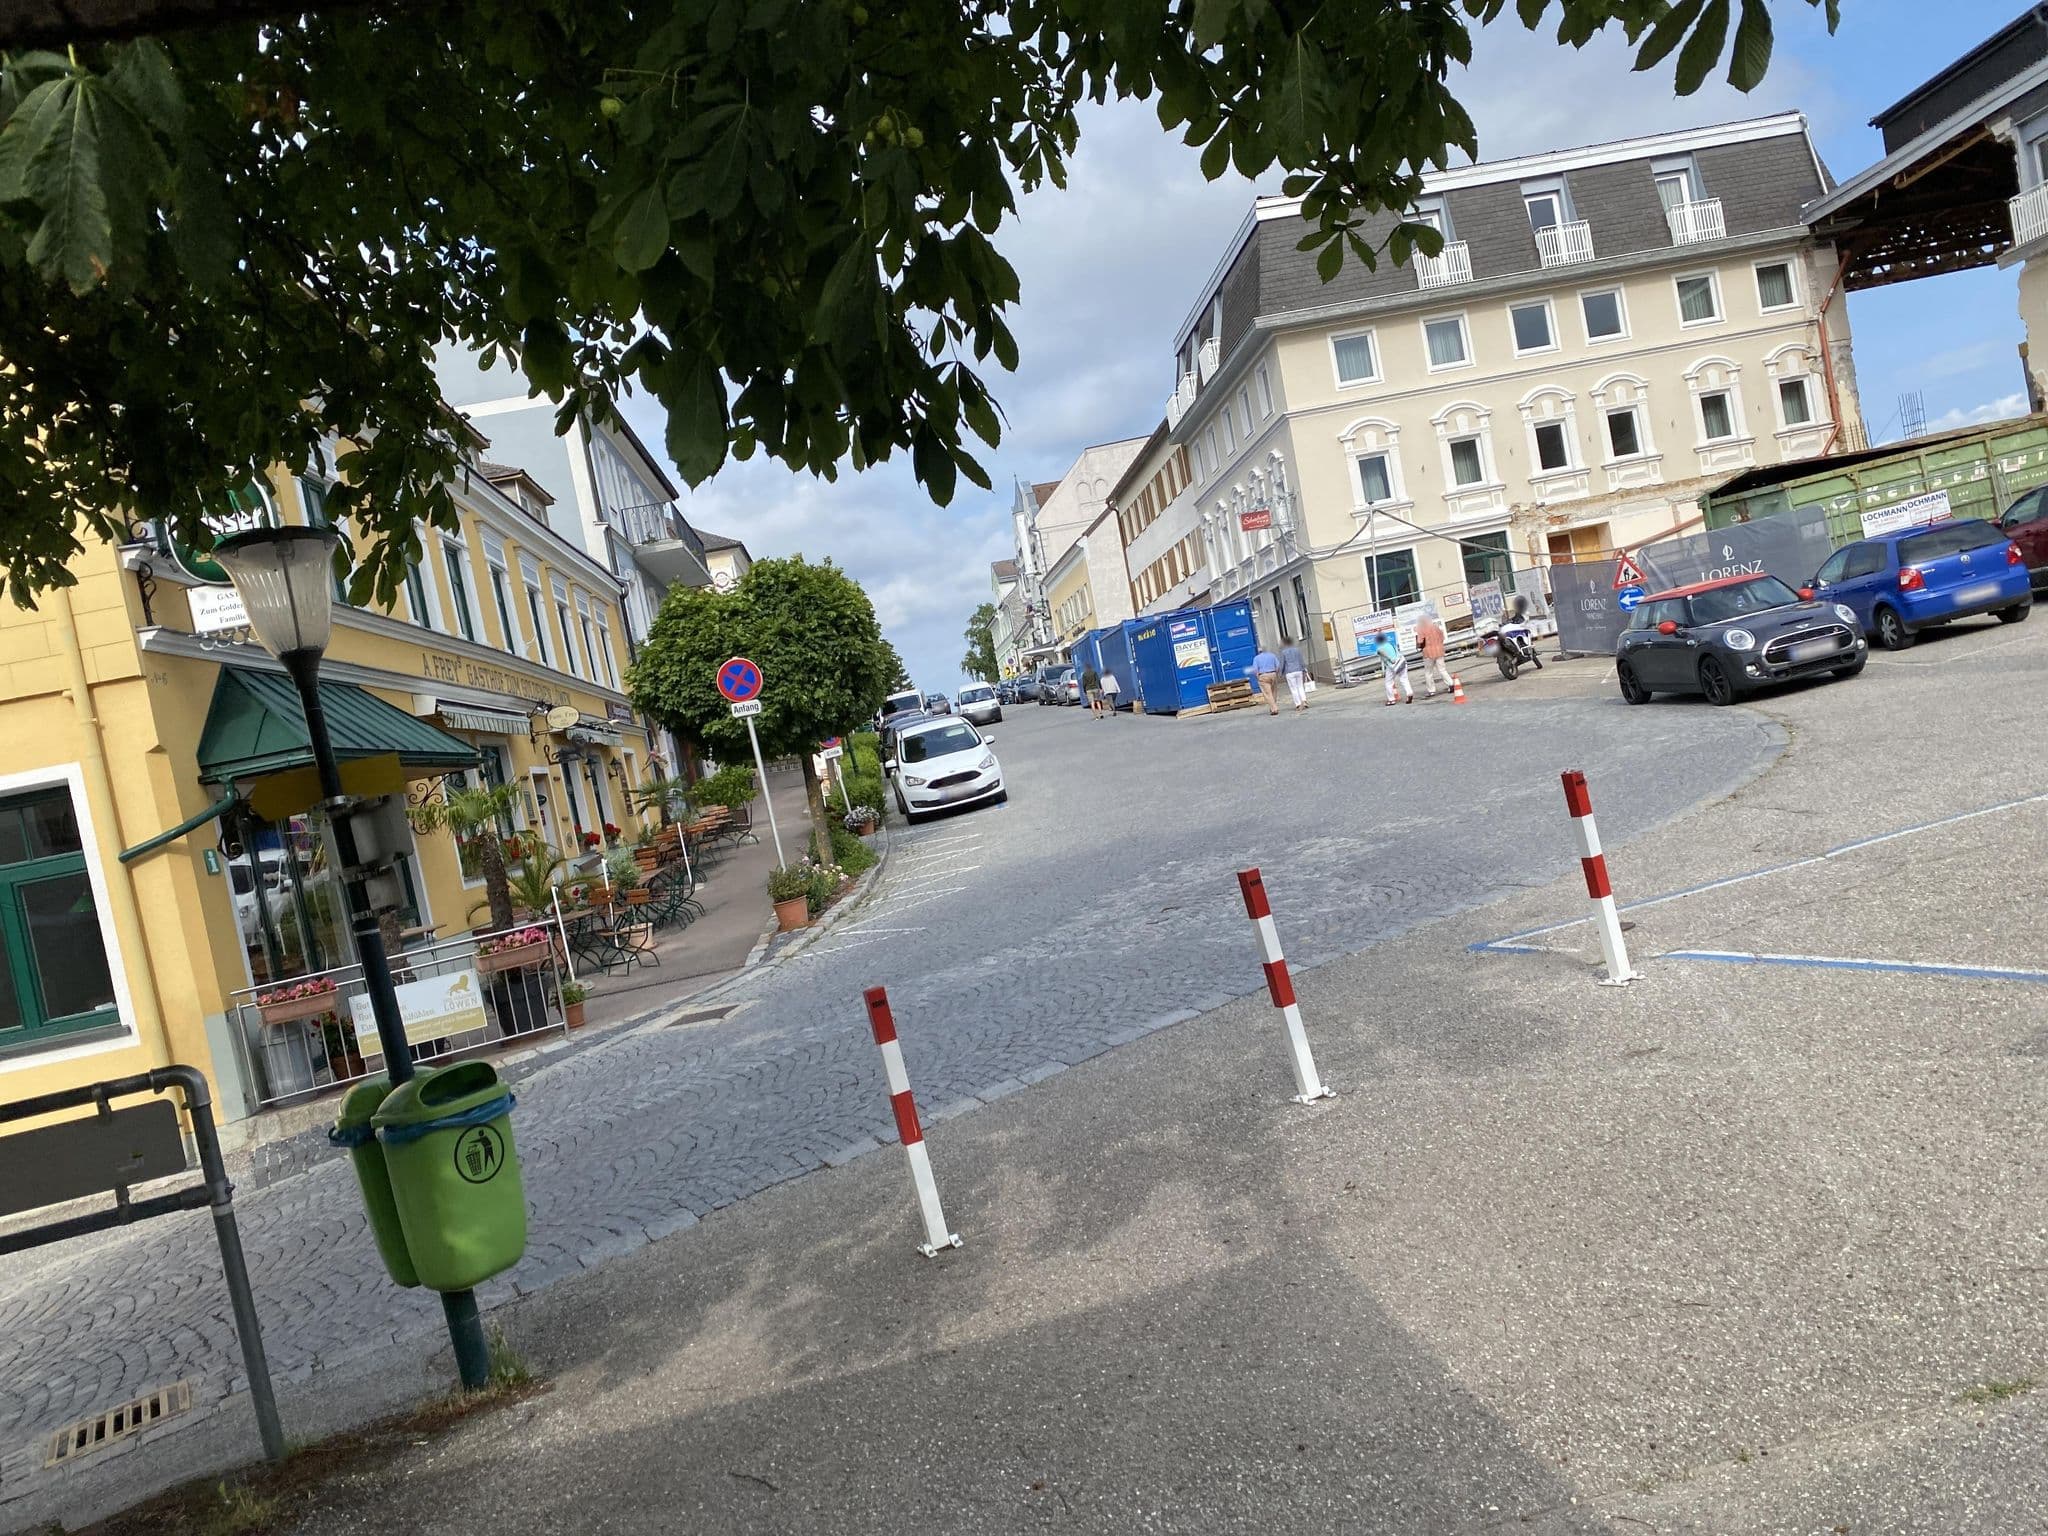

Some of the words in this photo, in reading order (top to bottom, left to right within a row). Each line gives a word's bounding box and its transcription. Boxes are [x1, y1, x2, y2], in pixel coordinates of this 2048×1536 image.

[1907, 492, 1948, 509] OCHMANN
[1863, 506, 1908, 522] LOCHMANN
[1700, 559, 1764, 581] LORENZ
[1580, 598, 1607, 611] LORENZ
[1353, 610, 1391, 624] LOCHMANN
[1175, 641, 1206, 652] BAYER
[733, 702, 760, 714] Anfang
